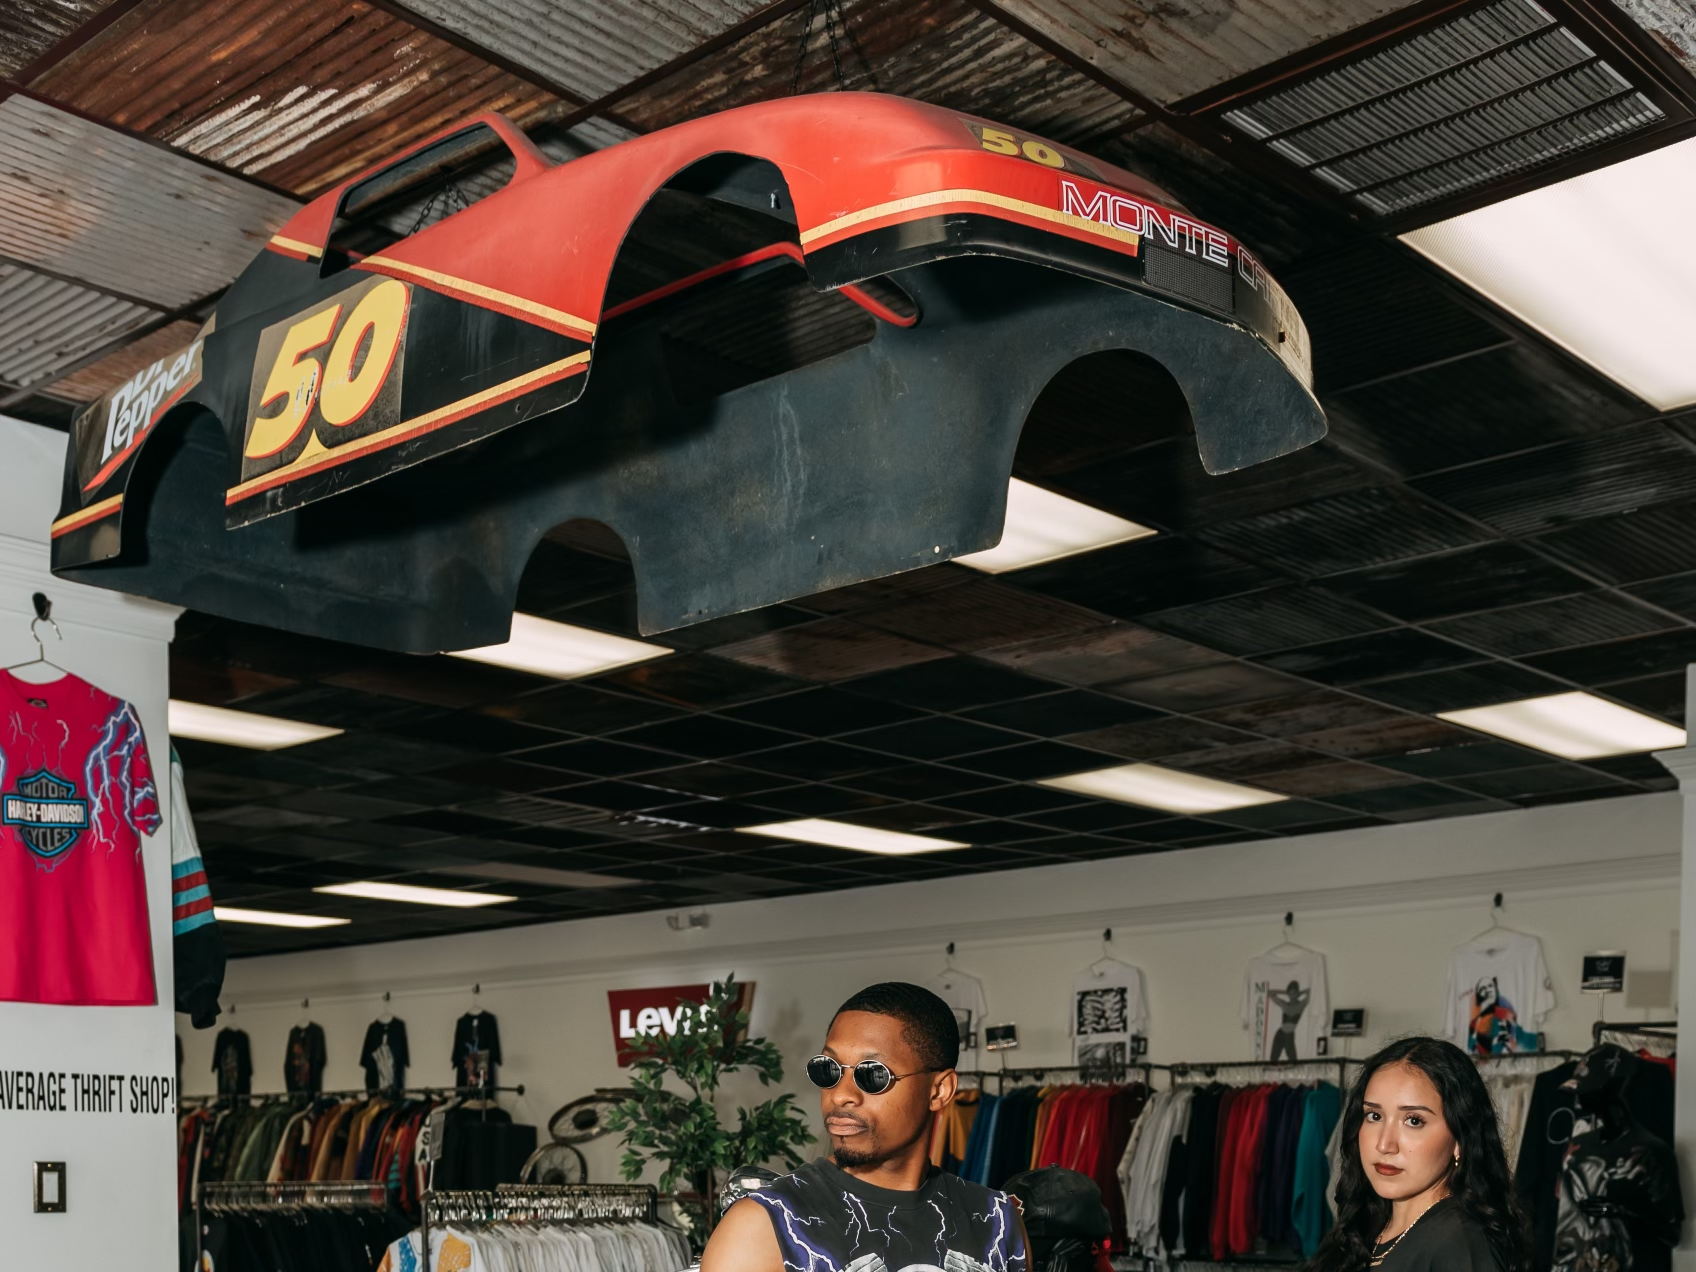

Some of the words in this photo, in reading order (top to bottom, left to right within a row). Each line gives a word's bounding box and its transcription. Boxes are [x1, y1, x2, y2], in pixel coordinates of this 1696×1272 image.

[981, 127, 1065, 169] 50
[1061, 180, 1229, 268] MONTE
[245, 279, 410, 460] 50
[100, 340, 202, 465] Pepper
[23, 777, 67, 799] MOTOR
[7, 799, 85, 824] HARLEY-DAVIDSON
[0, 1070, 67, 1112] AVERAGE
[71, 1073, 125, 1113] THRIFT
[130, 1074, 175, 1115] SHOP!
